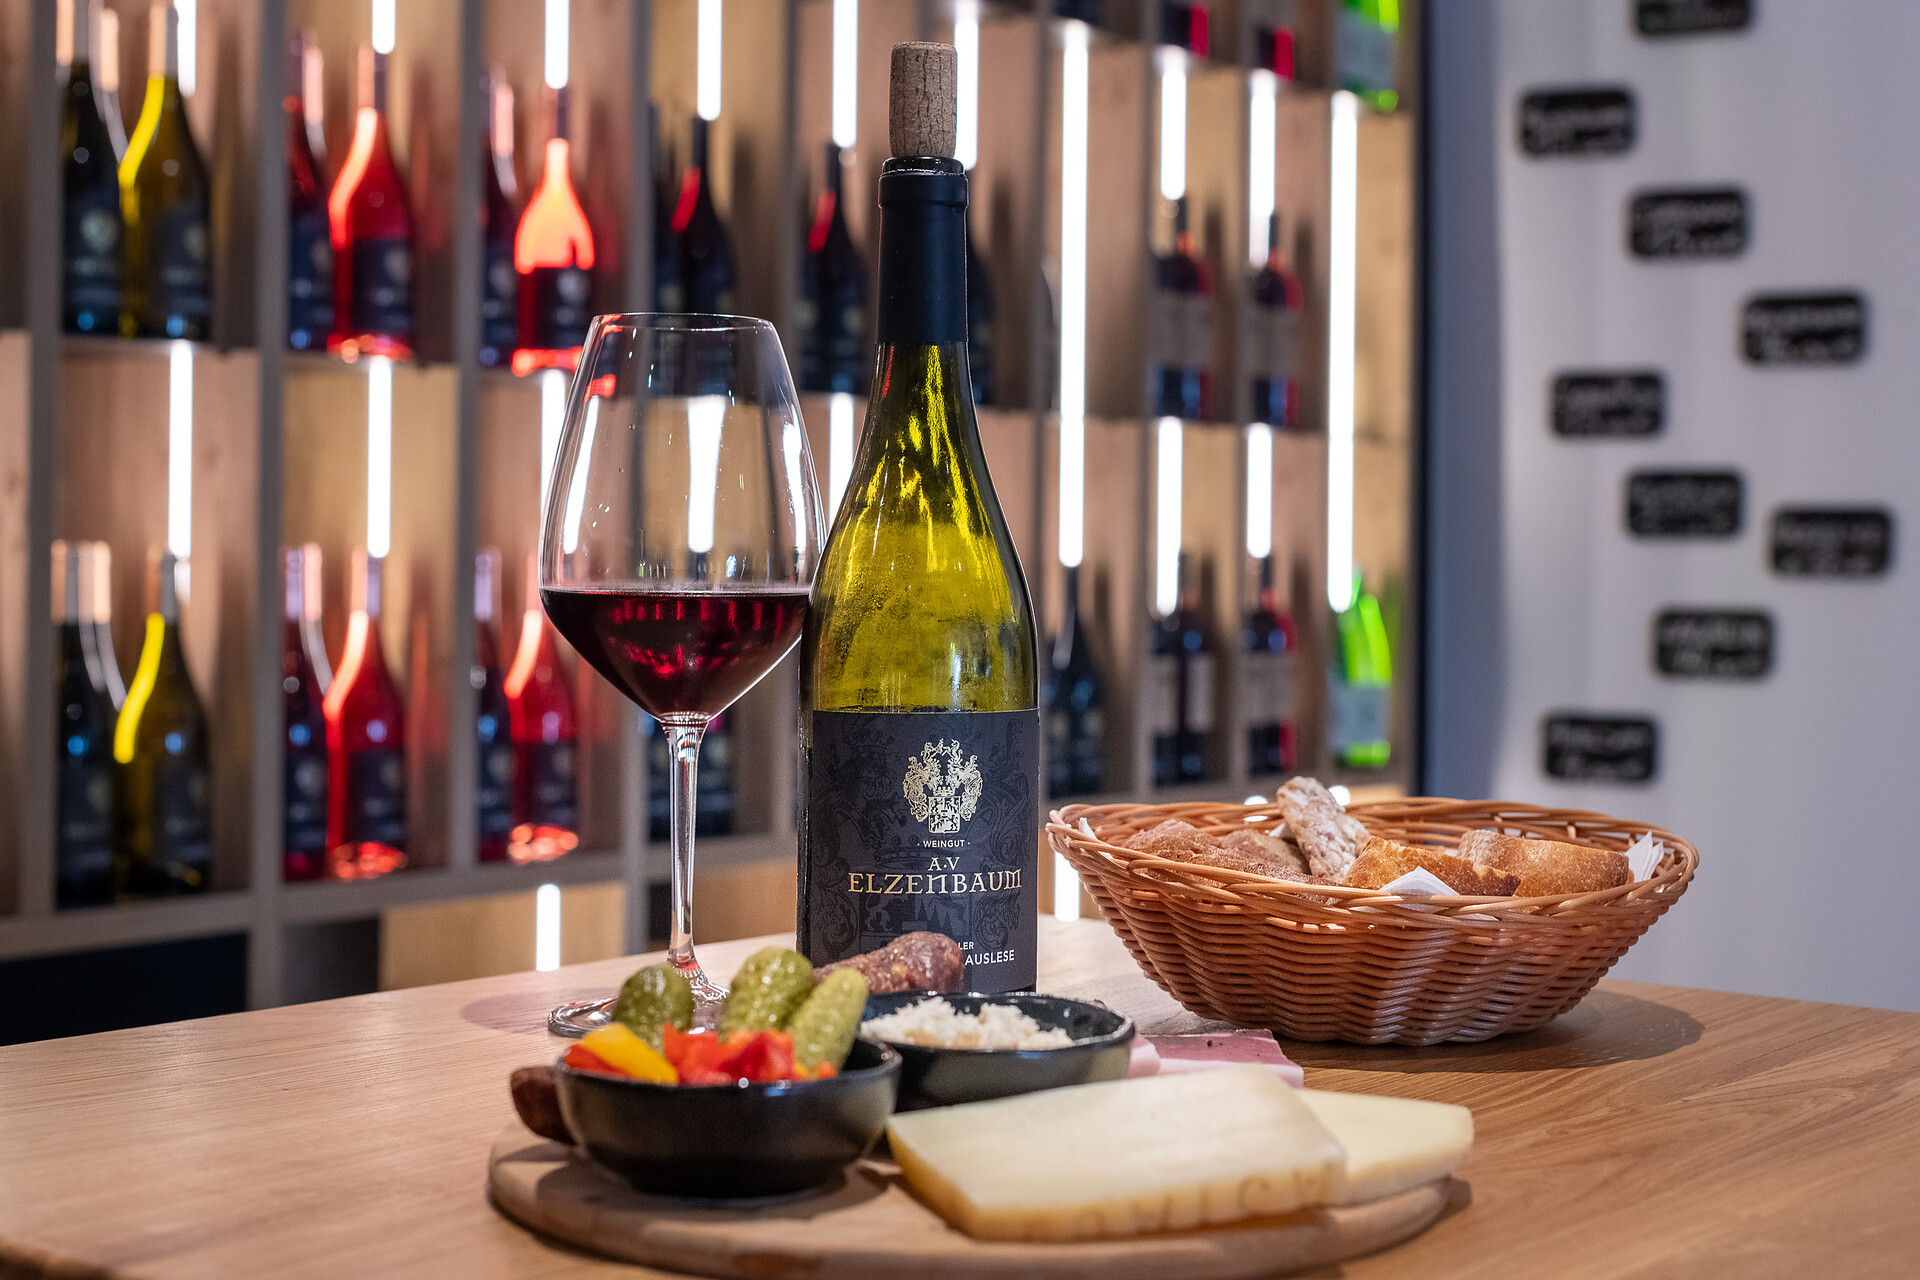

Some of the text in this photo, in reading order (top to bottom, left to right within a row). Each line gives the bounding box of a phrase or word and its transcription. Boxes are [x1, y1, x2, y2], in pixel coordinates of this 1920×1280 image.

[923, 839, 965, 848] WEINGUT
[848, 868, 1022, 894] ELZENBAUM
[964, 949, 1015, 966] AUSLESE
